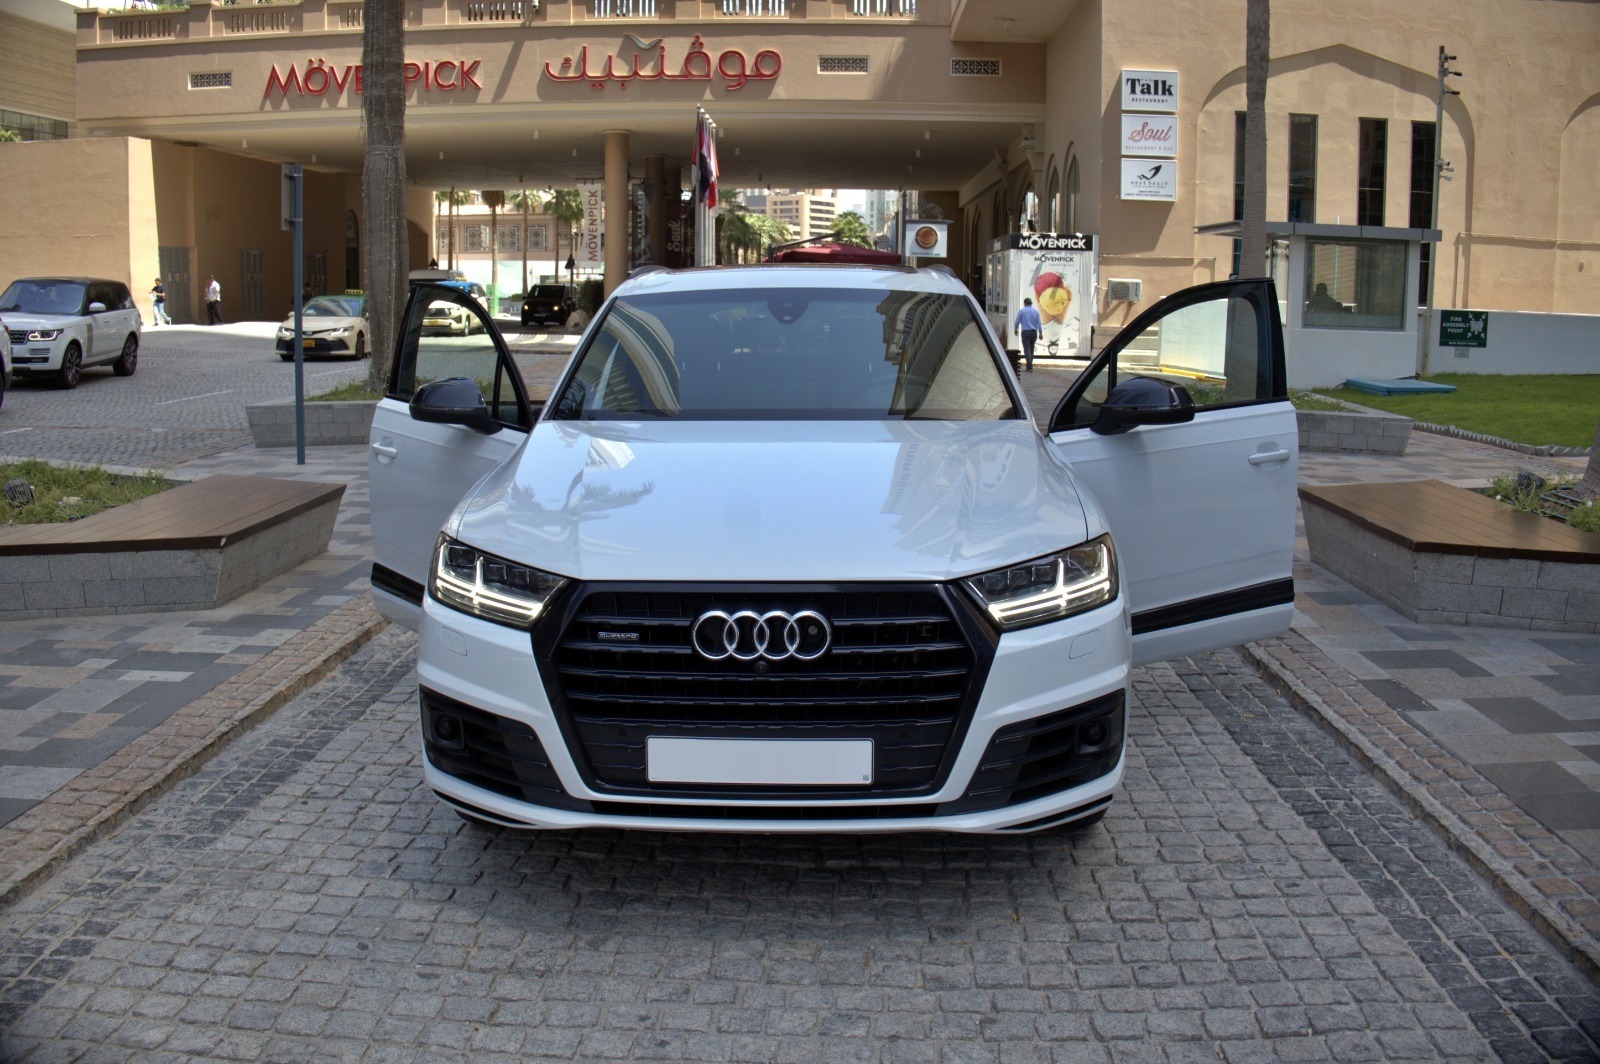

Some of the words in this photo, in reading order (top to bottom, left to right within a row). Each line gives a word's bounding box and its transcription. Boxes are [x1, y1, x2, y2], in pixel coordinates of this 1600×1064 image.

[264, 57, 483, 96] MÖVEPICK
[1126, 78, 1174, 96] Talk
[1128, 121, 1172, 142] Soul
[667, 220, 680, 252] Soul
